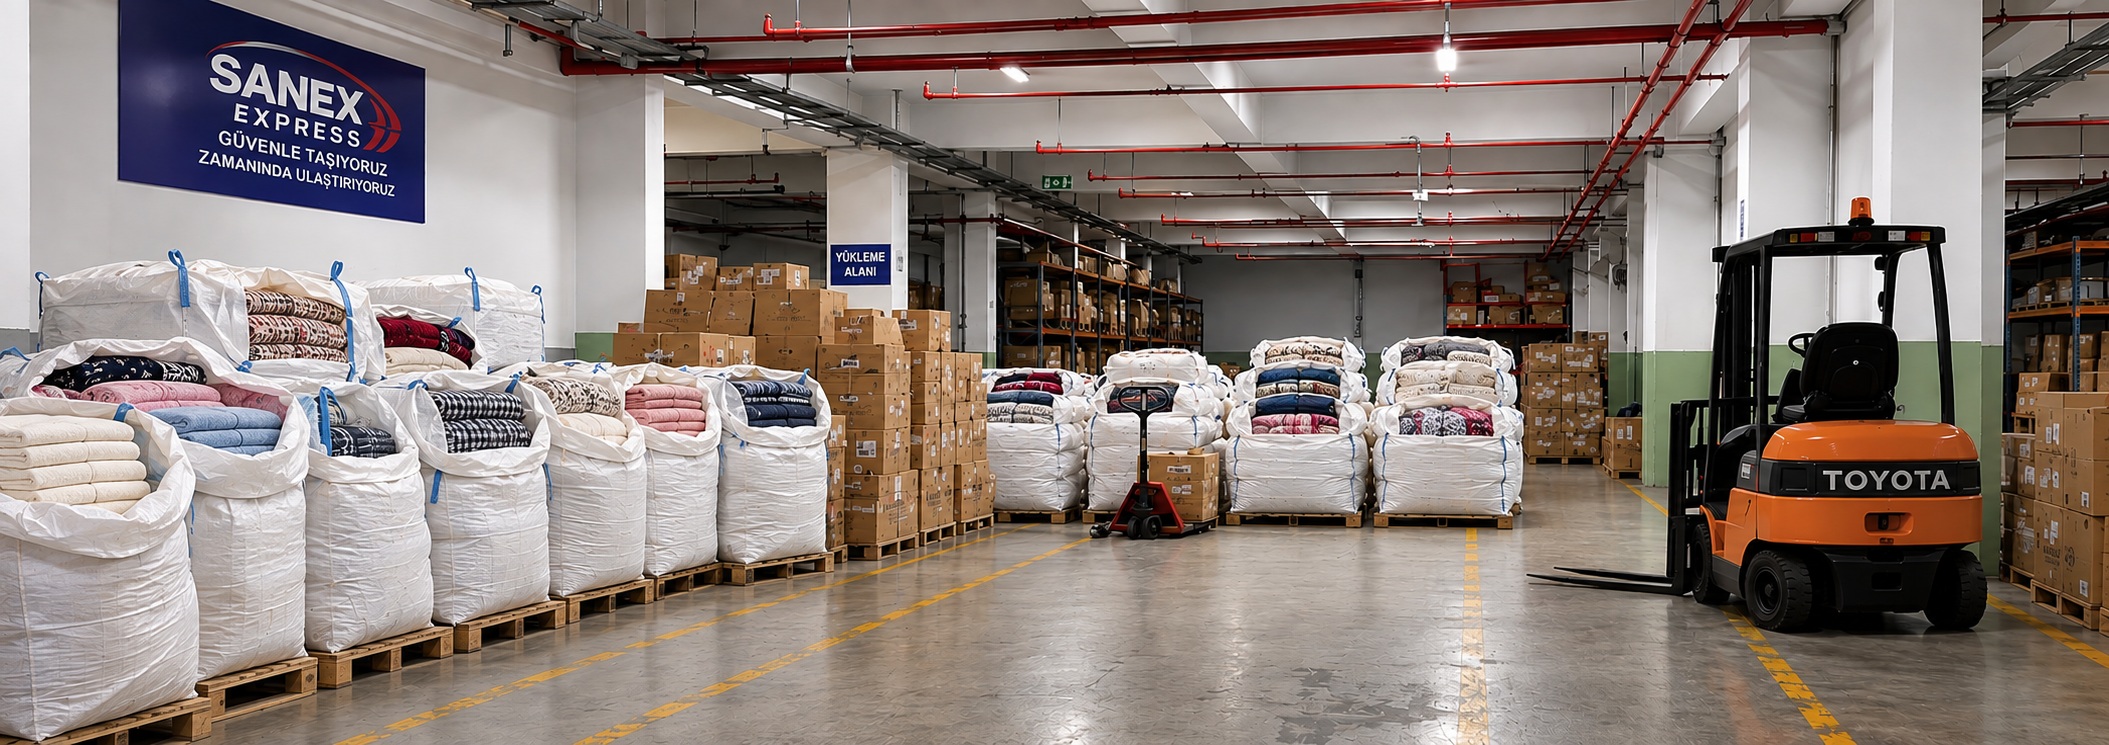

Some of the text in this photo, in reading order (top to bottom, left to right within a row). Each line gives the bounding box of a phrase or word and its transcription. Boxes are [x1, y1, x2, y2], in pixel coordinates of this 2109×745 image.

[209, 53, 363, 125] SANEX
[233, 102, 360, 148] EXPRESS
[198, 149, 395, 197] ZAMANINDA ULAŞTIRIYORUZ
[218, 130, 388, 177] GÜVENLE TAŞIYORUZ
[835, 249, 886, 262] YÜKLEME
[844, 266, 877, 277] ALANI
[1822, 470, 1951, 491] TOYOTA
